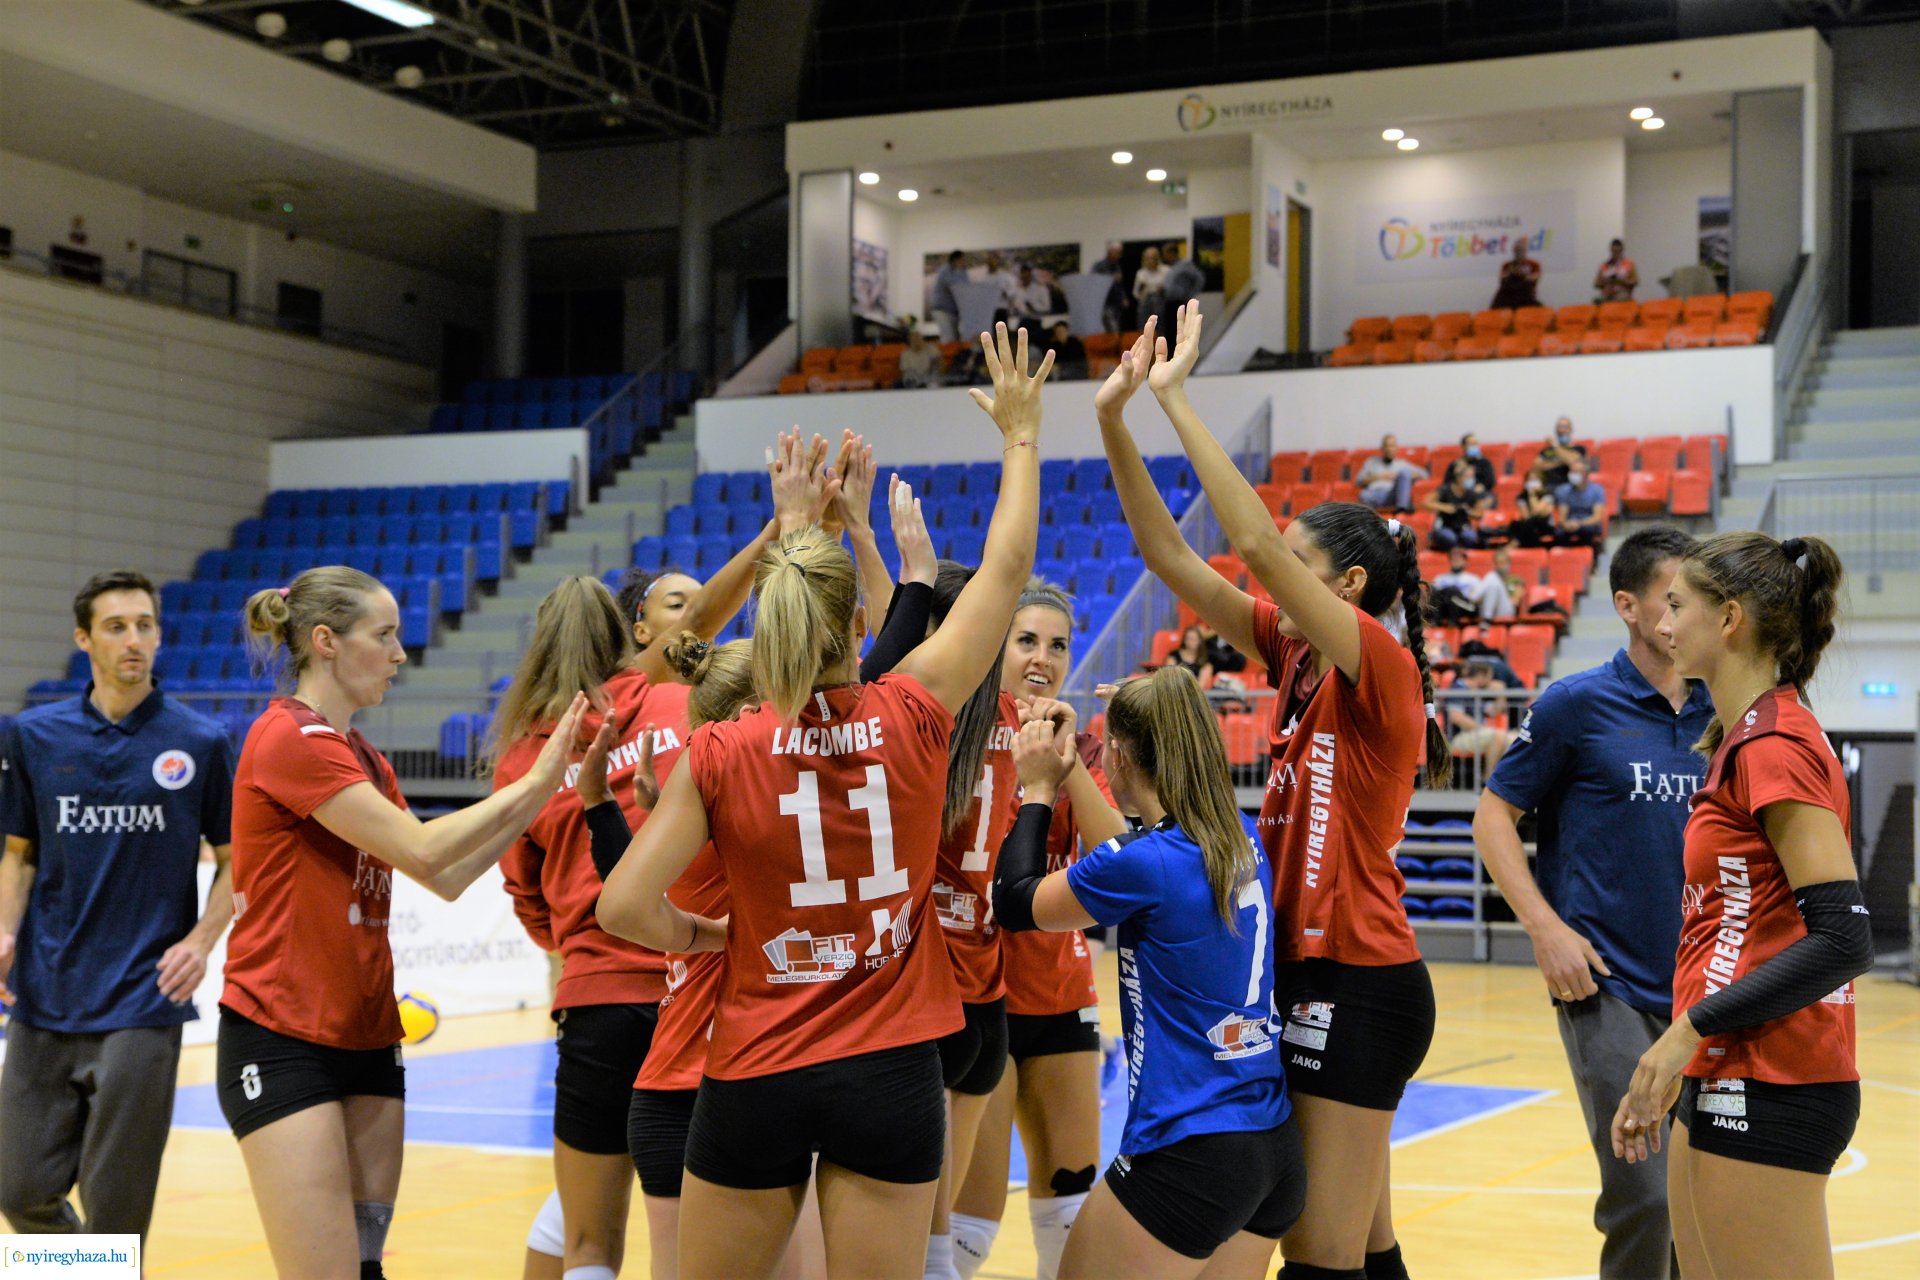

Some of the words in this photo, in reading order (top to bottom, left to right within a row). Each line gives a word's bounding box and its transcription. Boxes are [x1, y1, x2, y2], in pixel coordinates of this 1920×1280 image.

[1220, 96, 1333, 118] NYÍREGYHÁZA
[1430, 232, 1508, 260] Többet
[771, 716, 884, 757] LACOMBE
[56, 794, 165, 827] FATUM
[1306, 732, 1335, 889] NYÍREGYHÁZA
[778, 764, 910, 907] 11
[813, 935, 855, 955] FIT
[1237, 879, 1268, 1008] 7
[1291, 1054, 1322, 1071] JAKO
[1712, 1115, 1749, 1132] JAKO
